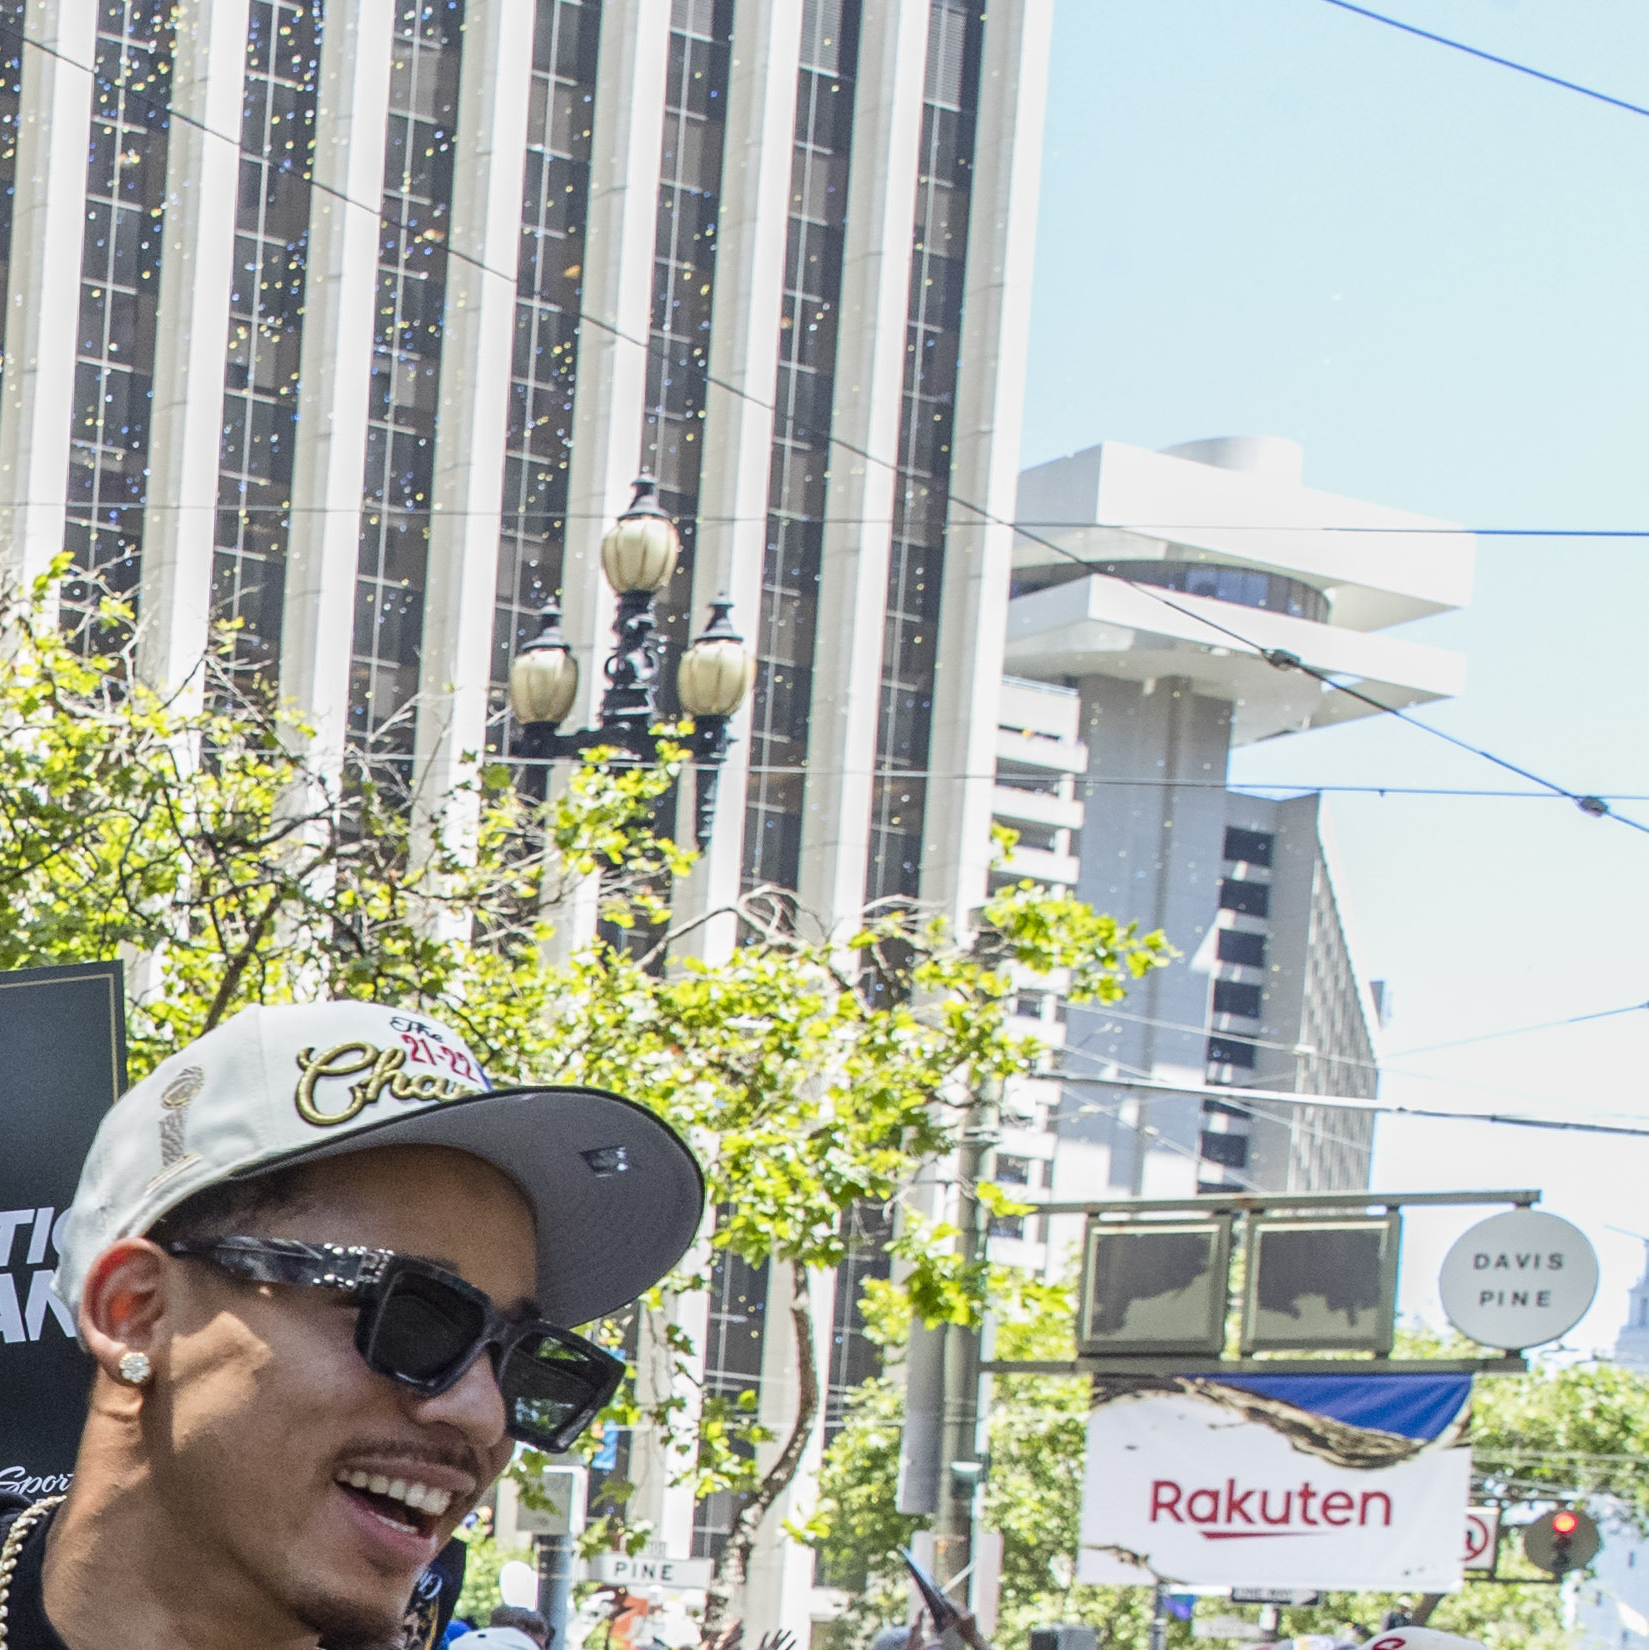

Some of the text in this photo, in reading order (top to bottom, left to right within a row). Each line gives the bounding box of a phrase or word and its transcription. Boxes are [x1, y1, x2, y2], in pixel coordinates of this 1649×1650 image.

[400, 1034, 479, 1083] 21-22
[1473, 1251, 1565, 1271] DAVIS
[1479, 1289, 1552, 1308] PINE
[1148, 1478, 1393, 1528] Rakuten
[615, 1561, 674, 1581] PINE
